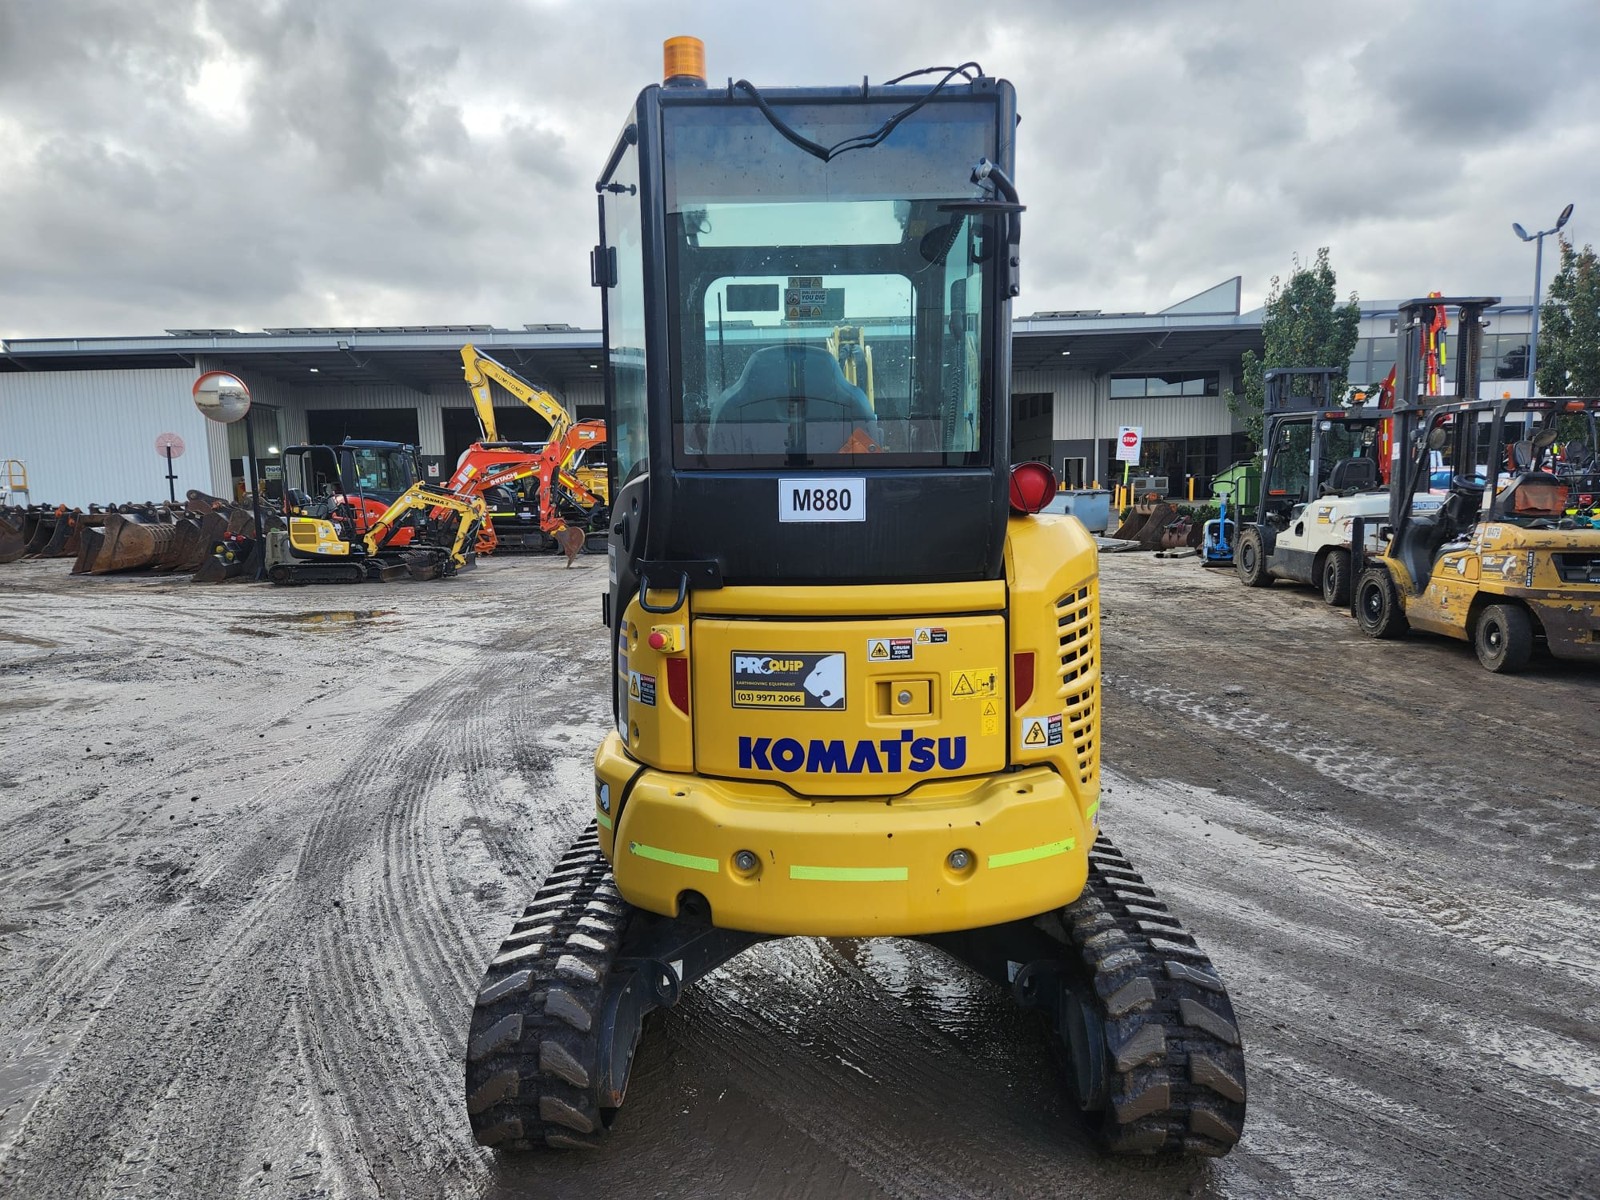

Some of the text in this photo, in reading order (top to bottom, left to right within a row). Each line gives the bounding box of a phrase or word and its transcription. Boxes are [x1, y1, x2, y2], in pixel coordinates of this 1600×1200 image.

[495, 372, 524, 396] SUMITOMO
[493, 471, 518, 485] HITACHI
[792, 488, 852, 511] M880
[737, 692, 801, 703] (03) 9971 2066
[738, 729, 967, 773] KOMATSU
